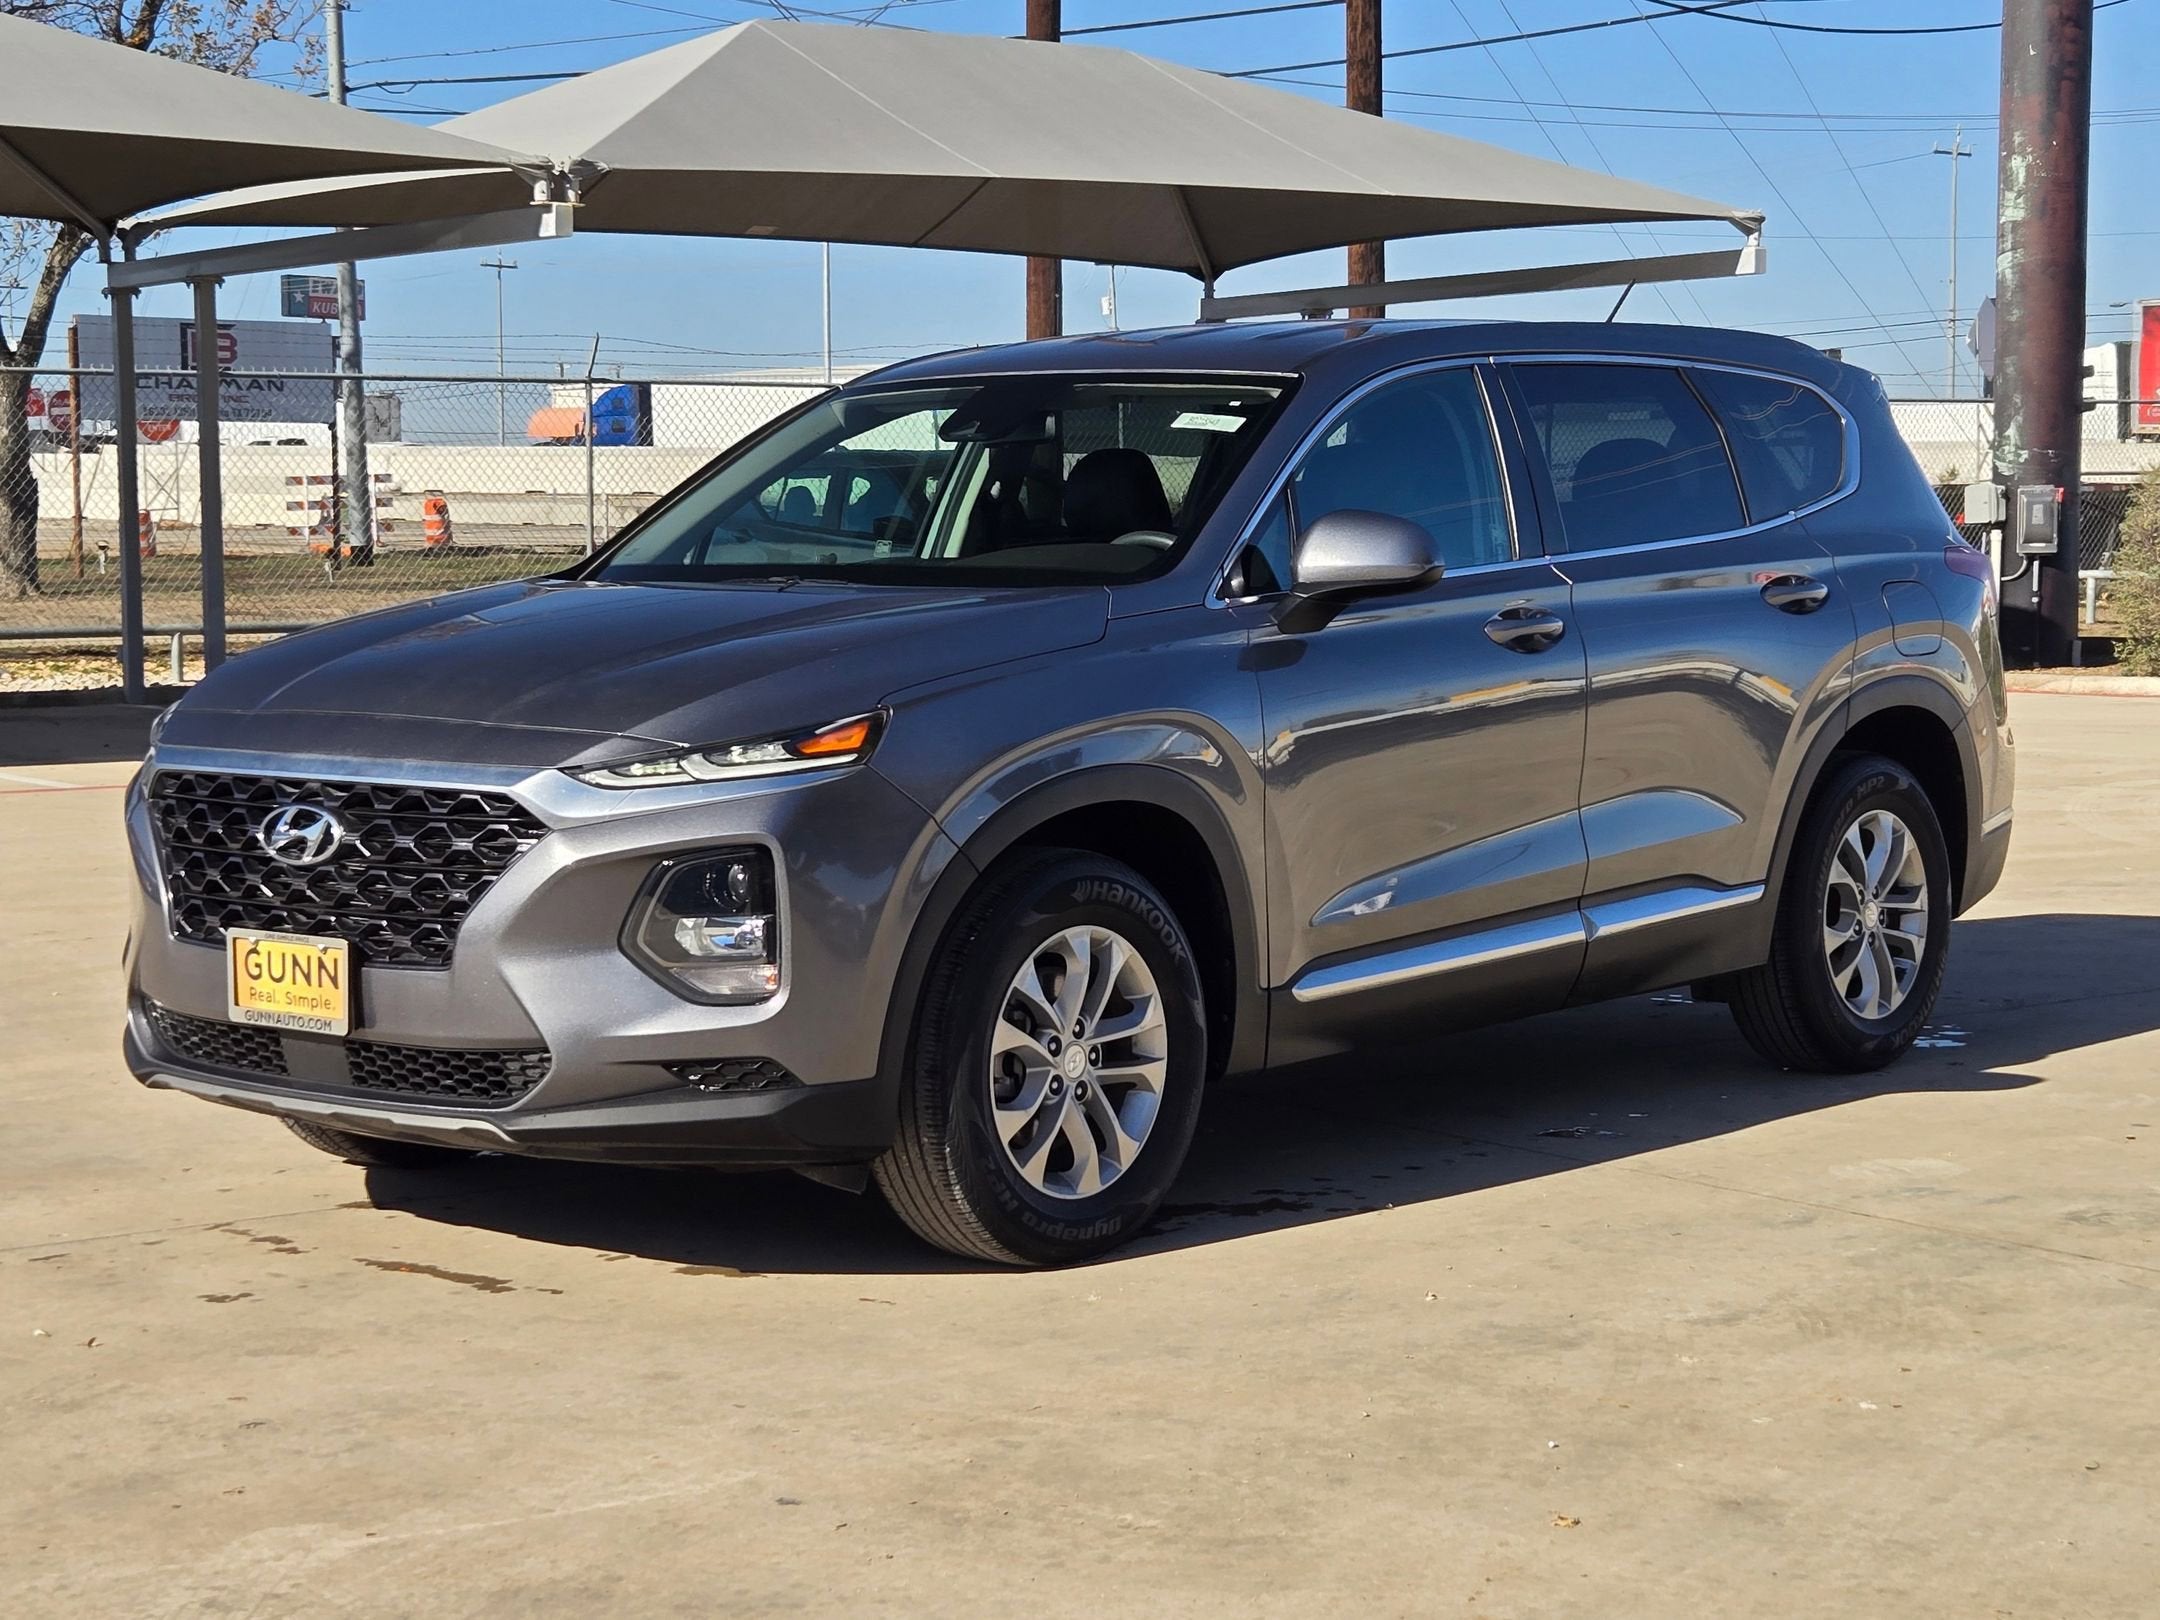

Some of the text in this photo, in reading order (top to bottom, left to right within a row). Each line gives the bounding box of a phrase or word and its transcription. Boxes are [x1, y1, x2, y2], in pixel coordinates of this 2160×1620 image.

[136, 376, 284, 392] CHAMAN
[244, 947, 340, 990] GUNN
[249, 986, 338, 1011] Real. Simple.
[244, 1009, 333, 1031] GUNNAUTO.COM
